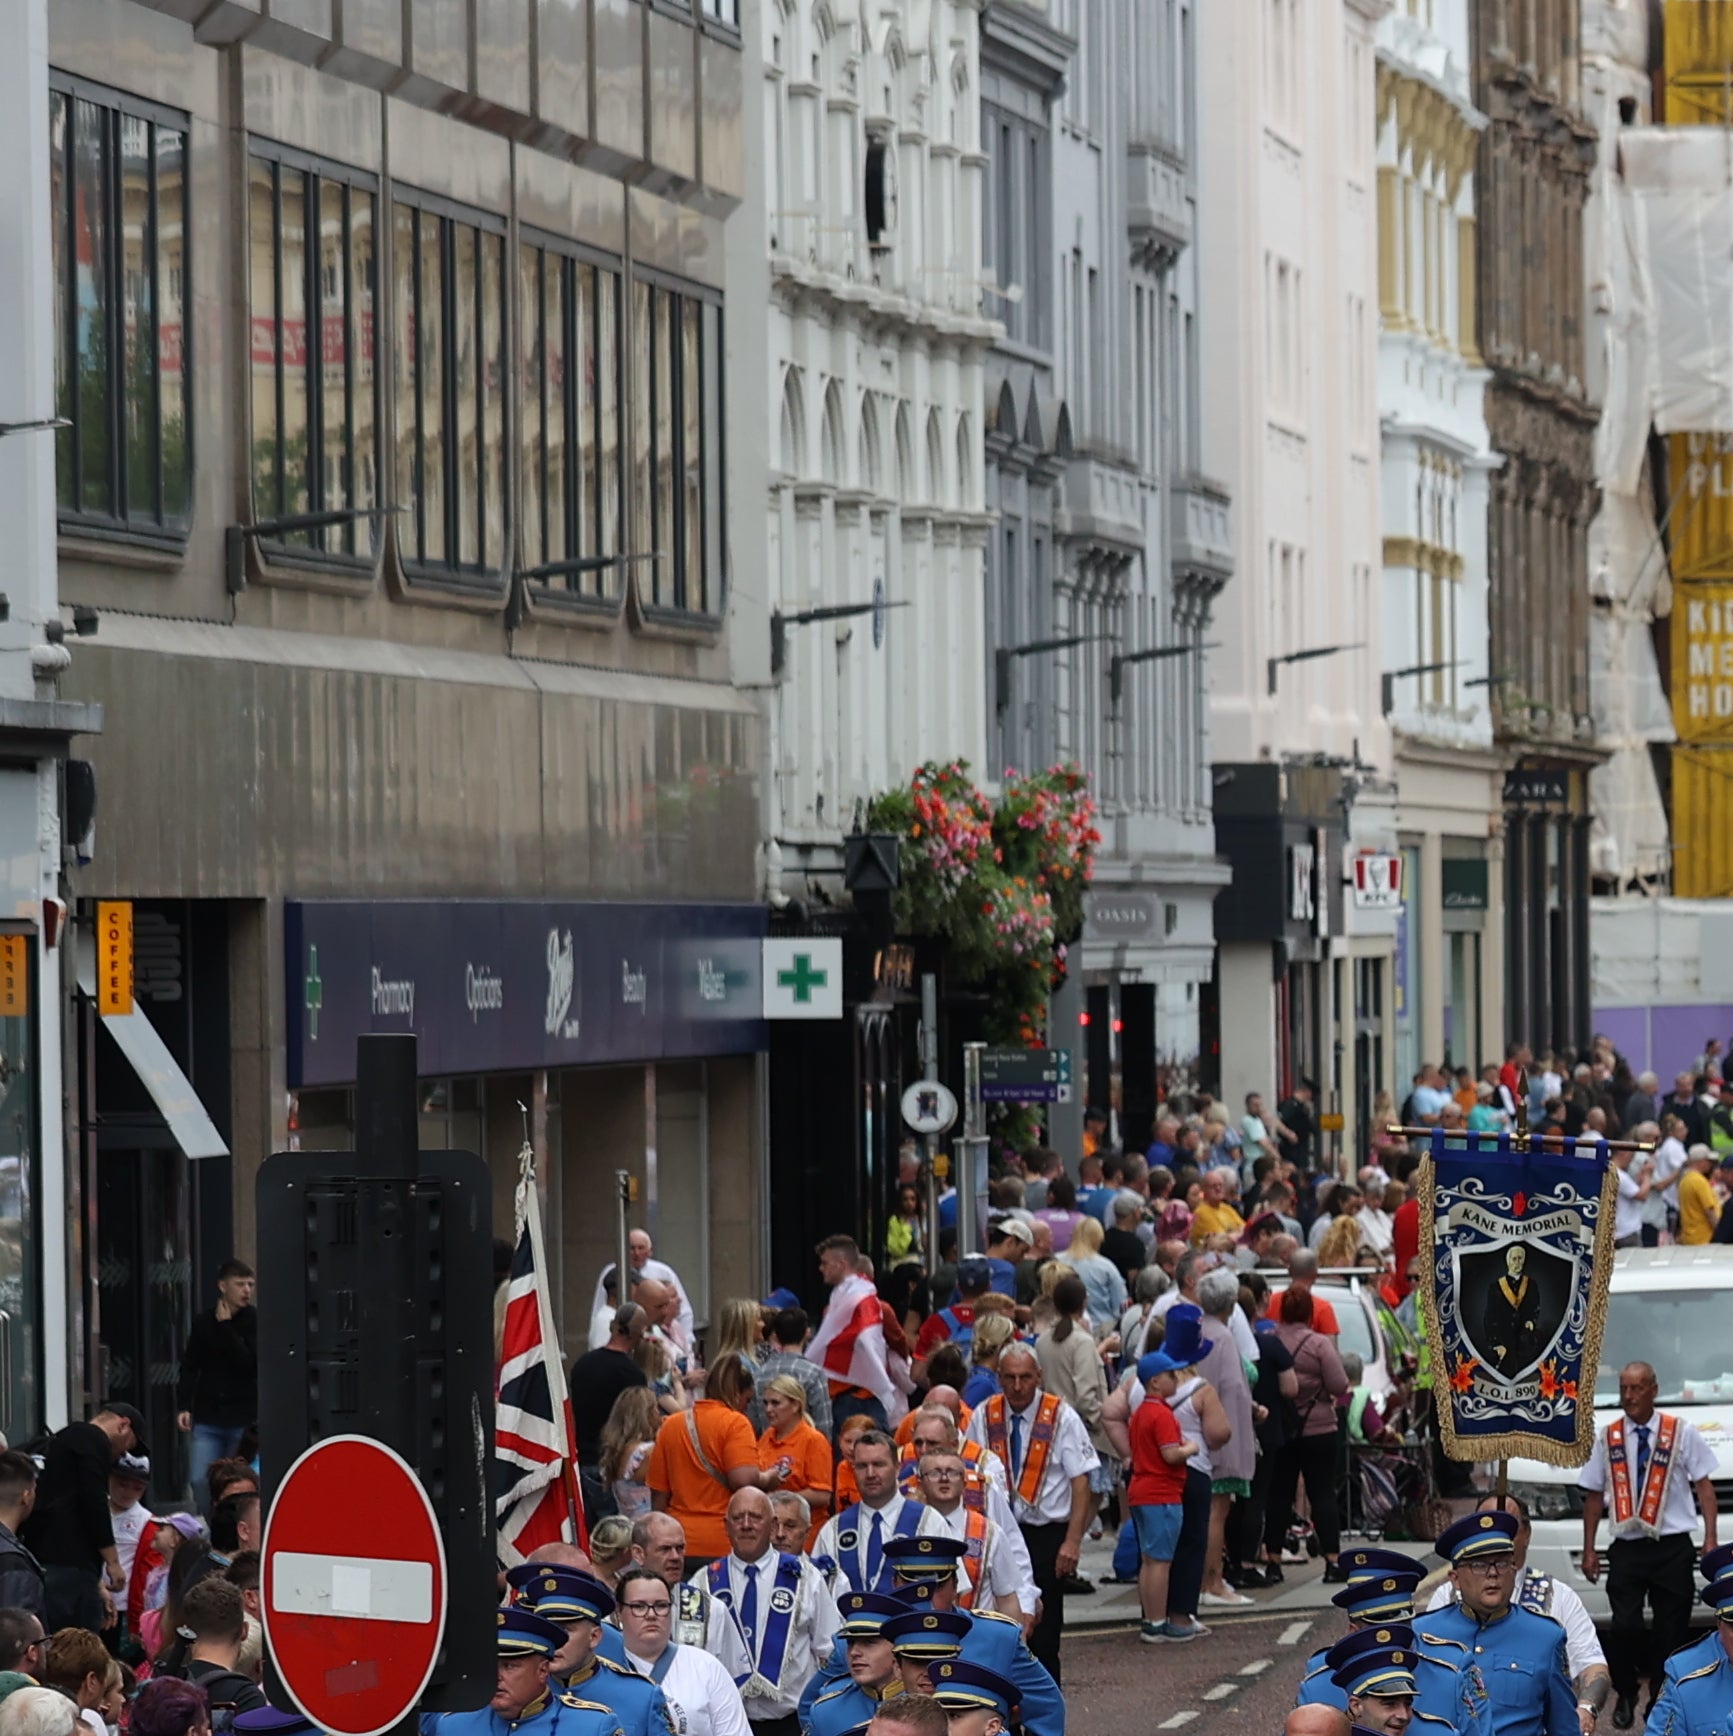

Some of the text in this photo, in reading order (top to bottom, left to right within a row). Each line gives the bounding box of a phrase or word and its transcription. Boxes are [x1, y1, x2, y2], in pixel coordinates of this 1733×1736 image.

[1094, 906, 1147, 925] OASIS
[109, 913, 120, 1004] COFFEE
[371, 963, 414, 1028] Pharmacy
[465, 962, 503, 1024] Opticians
[1462, 1208, 1572, 1236] KANE MEMORIAL
[1515, 1385, 1536, 1397] 890
